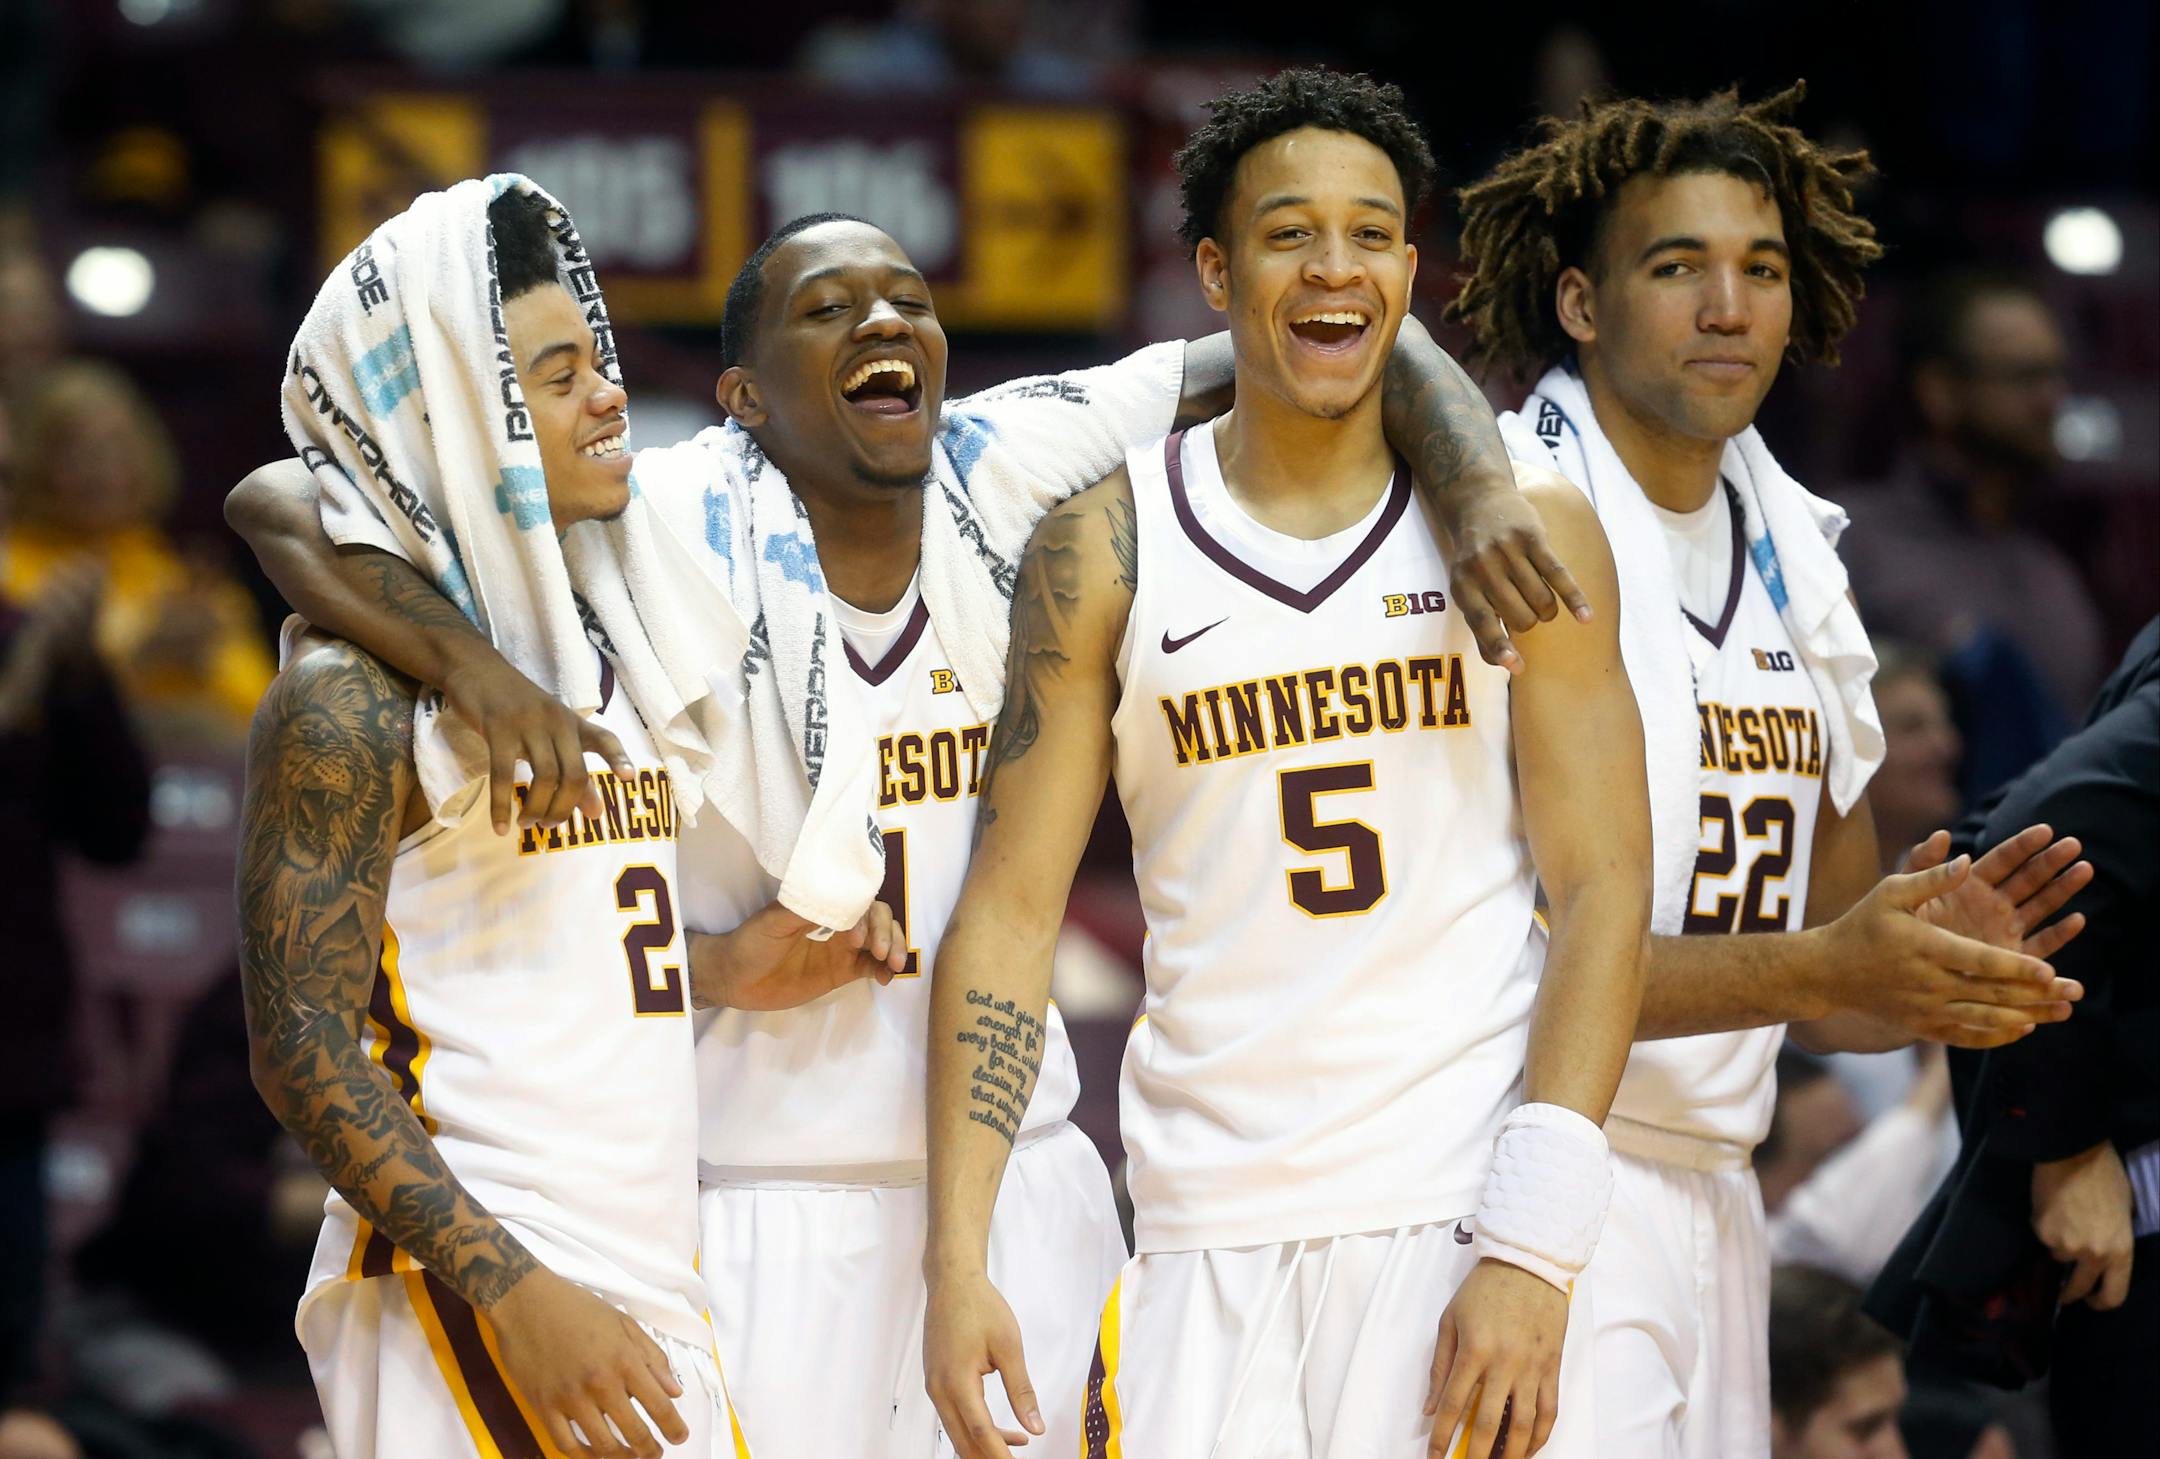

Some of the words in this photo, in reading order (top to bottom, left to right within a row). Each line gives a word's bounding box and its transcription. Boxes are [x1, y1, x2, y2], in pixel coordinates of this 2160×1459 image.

[1157, 653, 1472, 768] MINNESOTA
[1276, 759, 1390, 919] 5
[1682, 793, 1795, 934] 22
[613, 862, 686, 1017] 2
[966, 989, 992, 1008] God
[957, 1031, 988, 1051] every
[977, 1014, 1022, 1041] strength
[989, 1050, 1005, 1070] for
[970, 1084, 995, 1106] that
